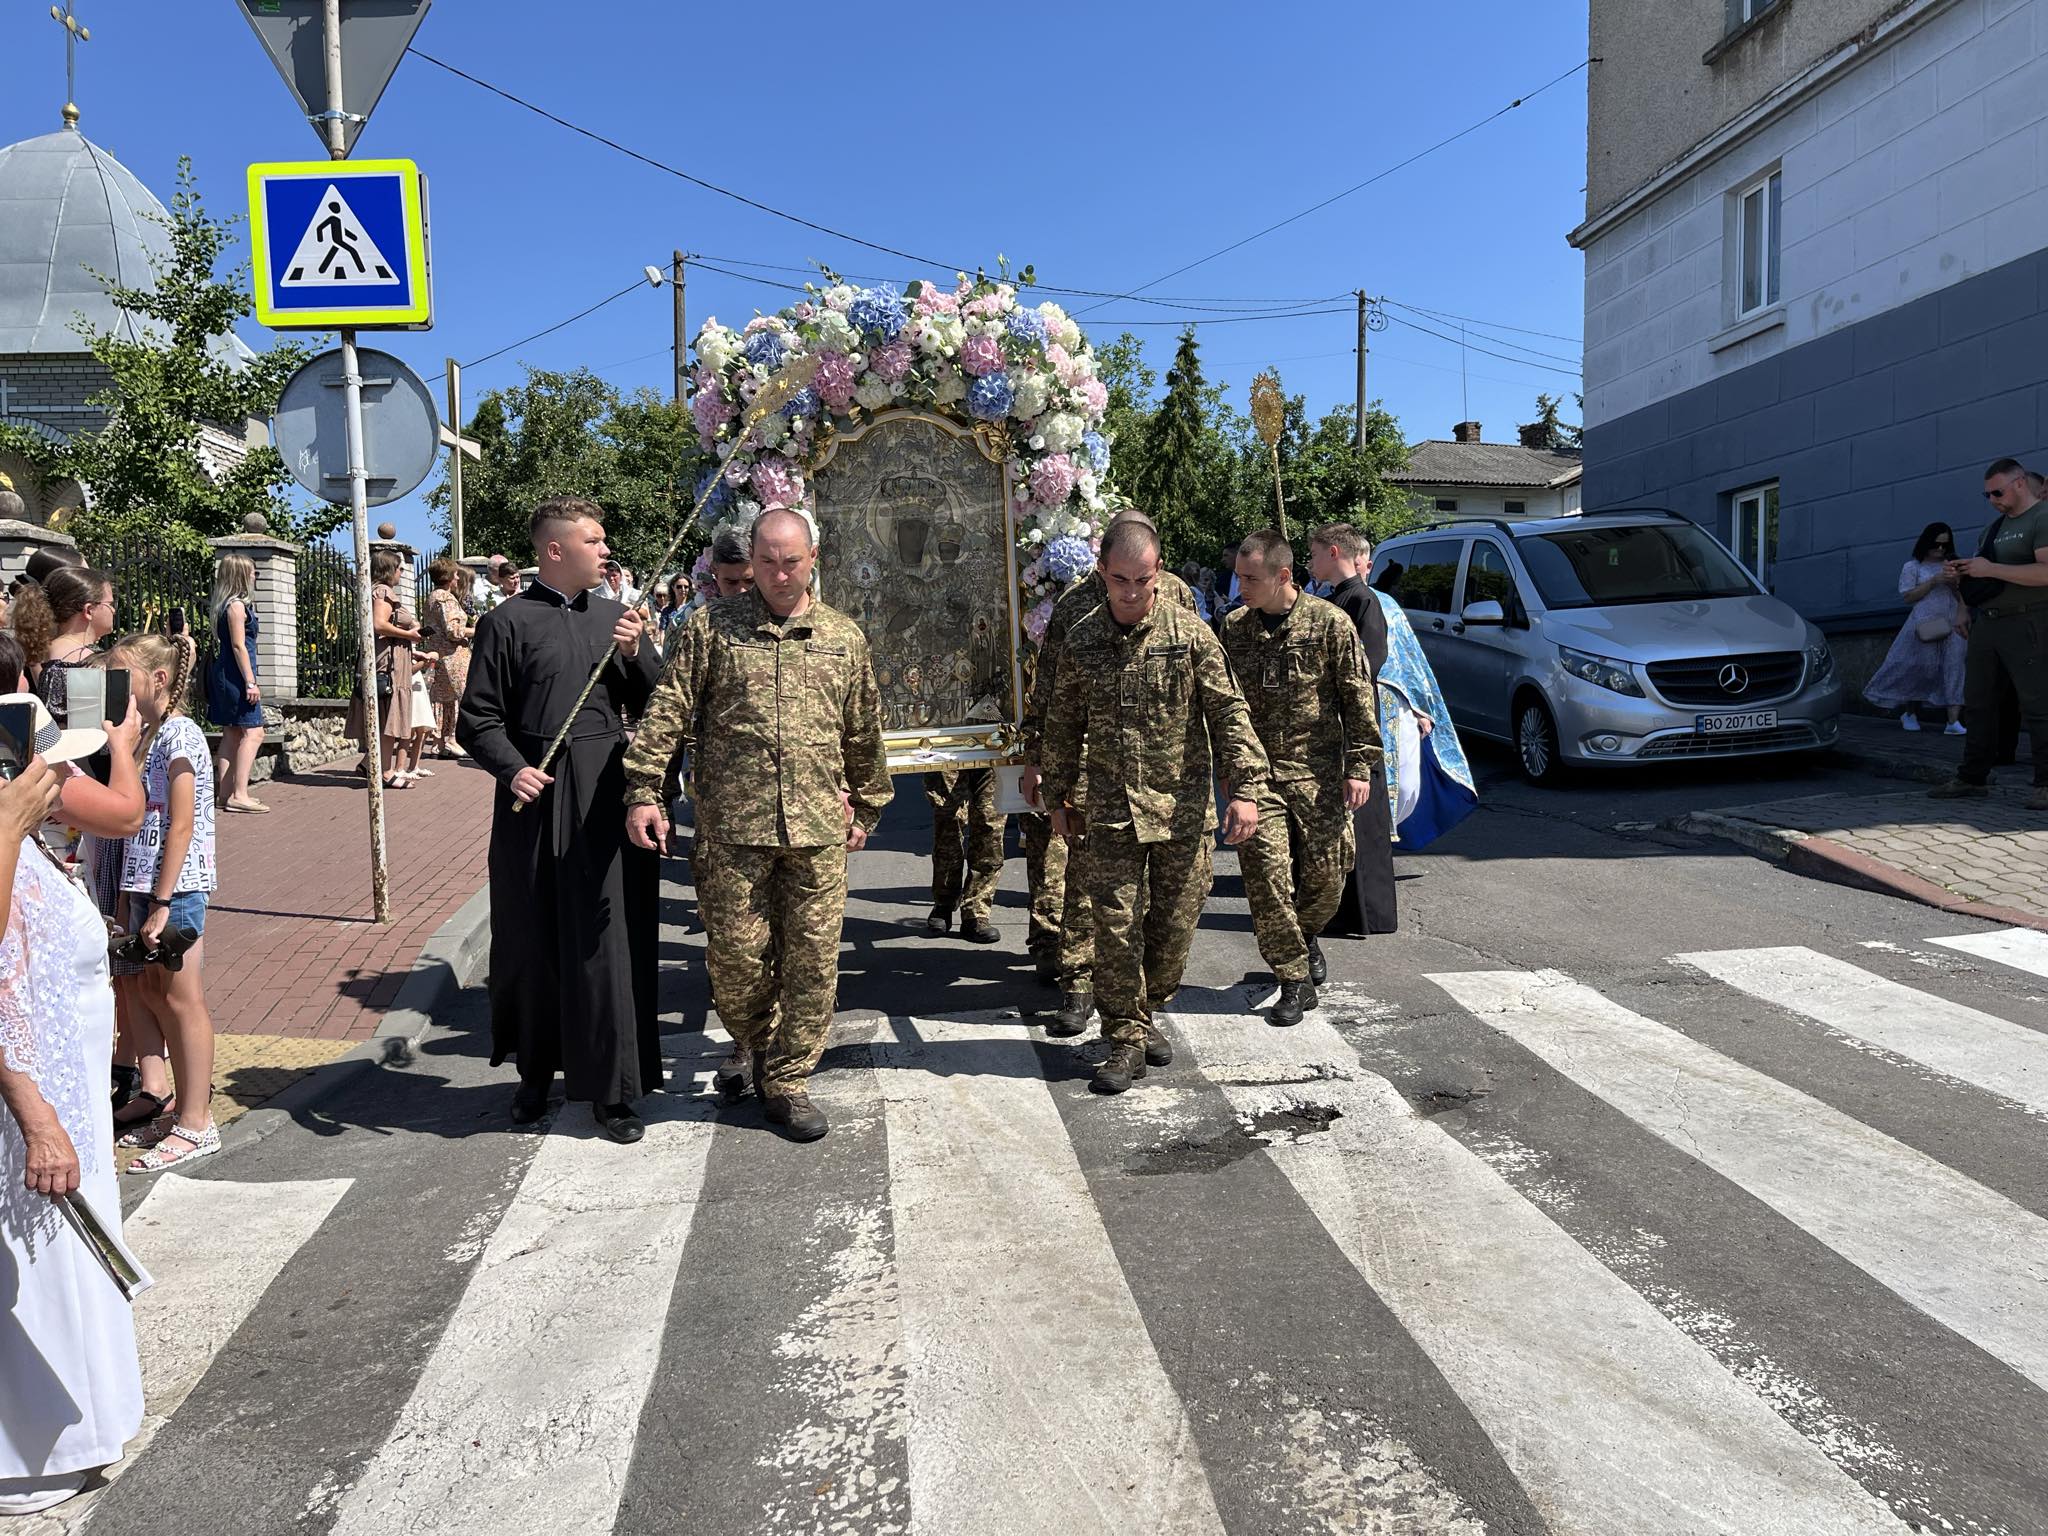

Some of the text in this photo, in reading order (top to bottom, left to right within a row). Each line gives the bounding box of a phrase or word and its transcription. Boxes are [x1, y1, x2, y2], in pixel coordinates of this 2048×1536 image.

[1704, 713, 1772, 731] BO 2071 CE
